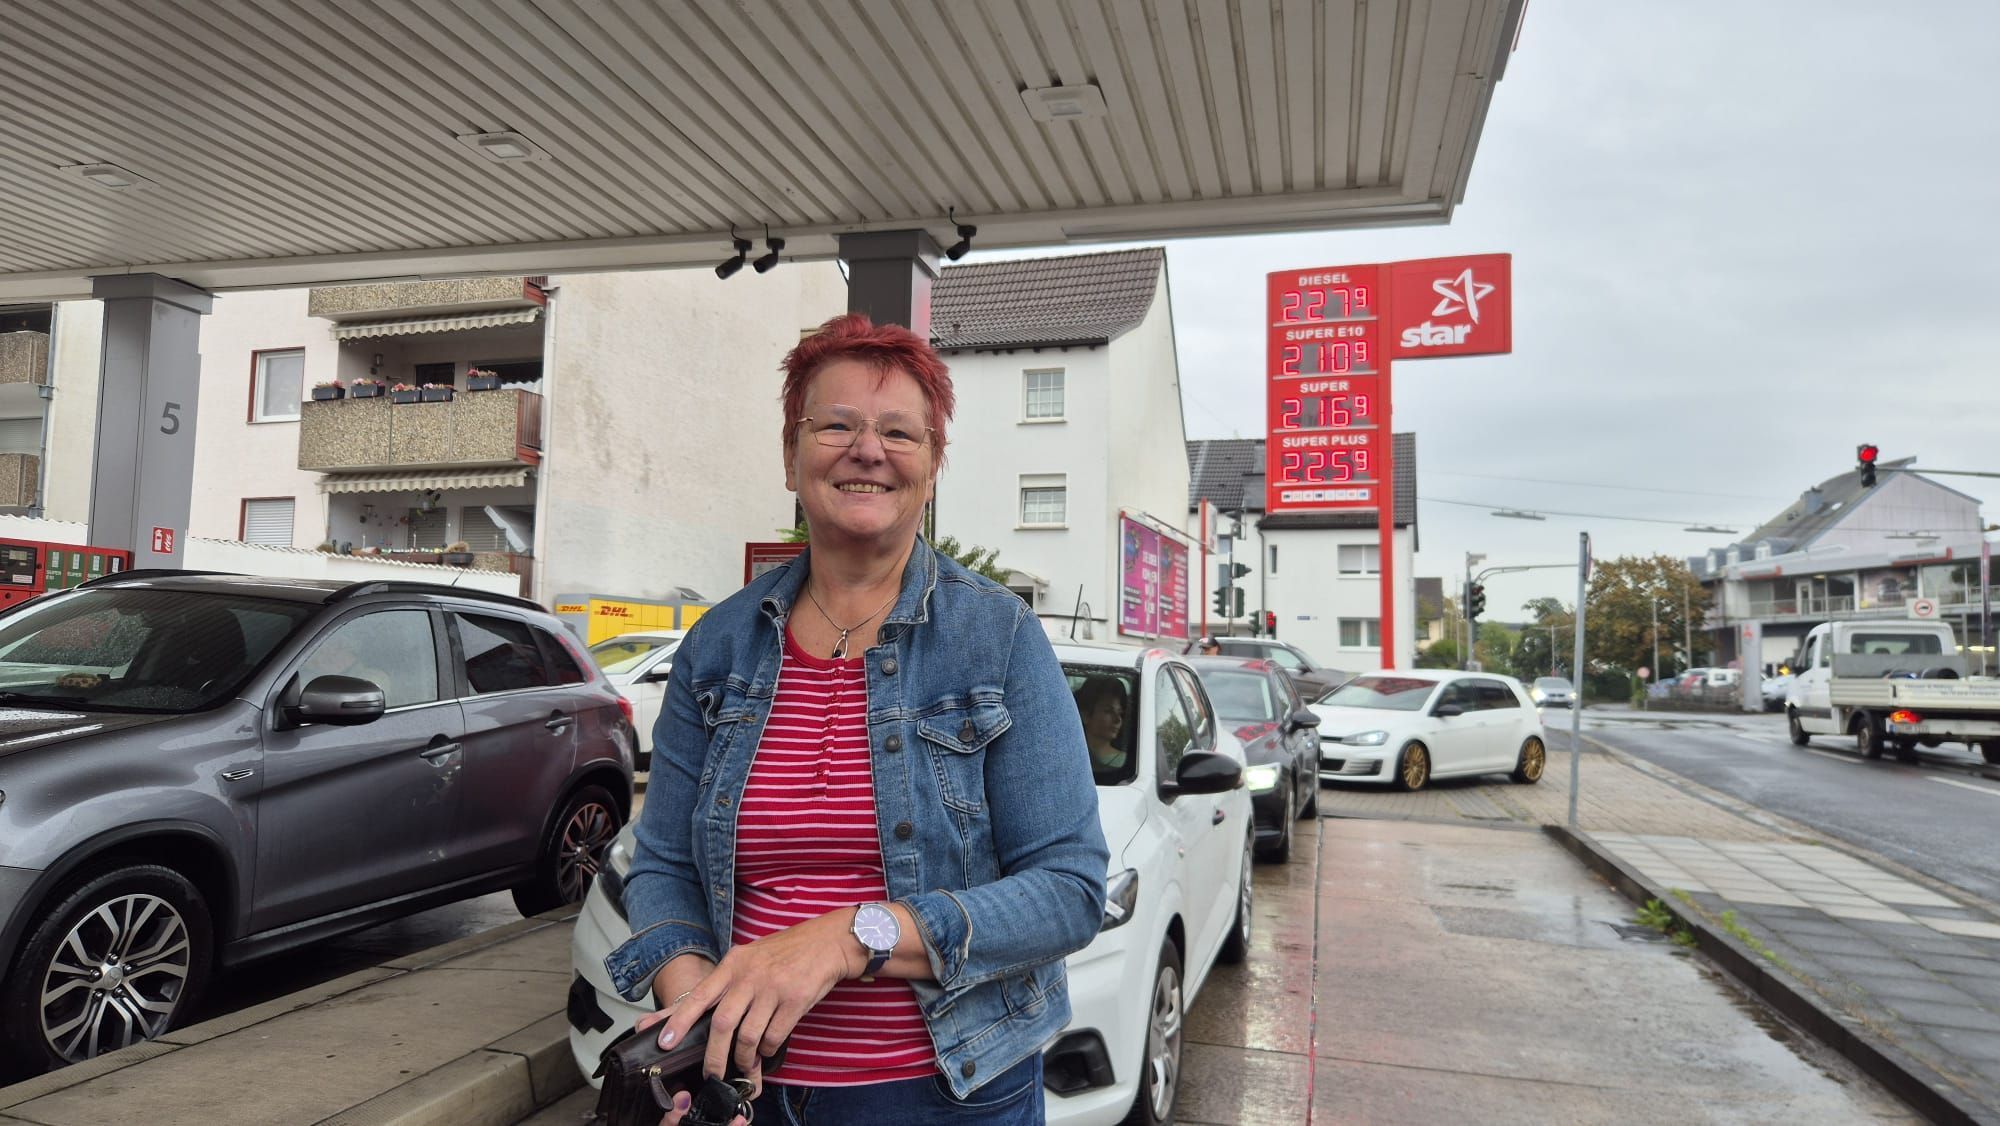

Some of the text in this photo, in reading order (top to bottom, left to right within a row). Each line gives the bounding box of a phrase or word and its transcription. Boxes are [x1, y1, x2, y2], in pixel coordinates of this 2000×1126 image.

[1298, 274, 1350, 286] DIESEL
[1286, 327, 1364, 341] SUPER E10
[1400, 321, 1472, 348] star
[1300, 381, 1349, 393] SUPER
[160, 401, 181, 435] 5
[1282, 434, 1368, 448] SUPER PLUS
[600, 605, 629, 617] DHL
